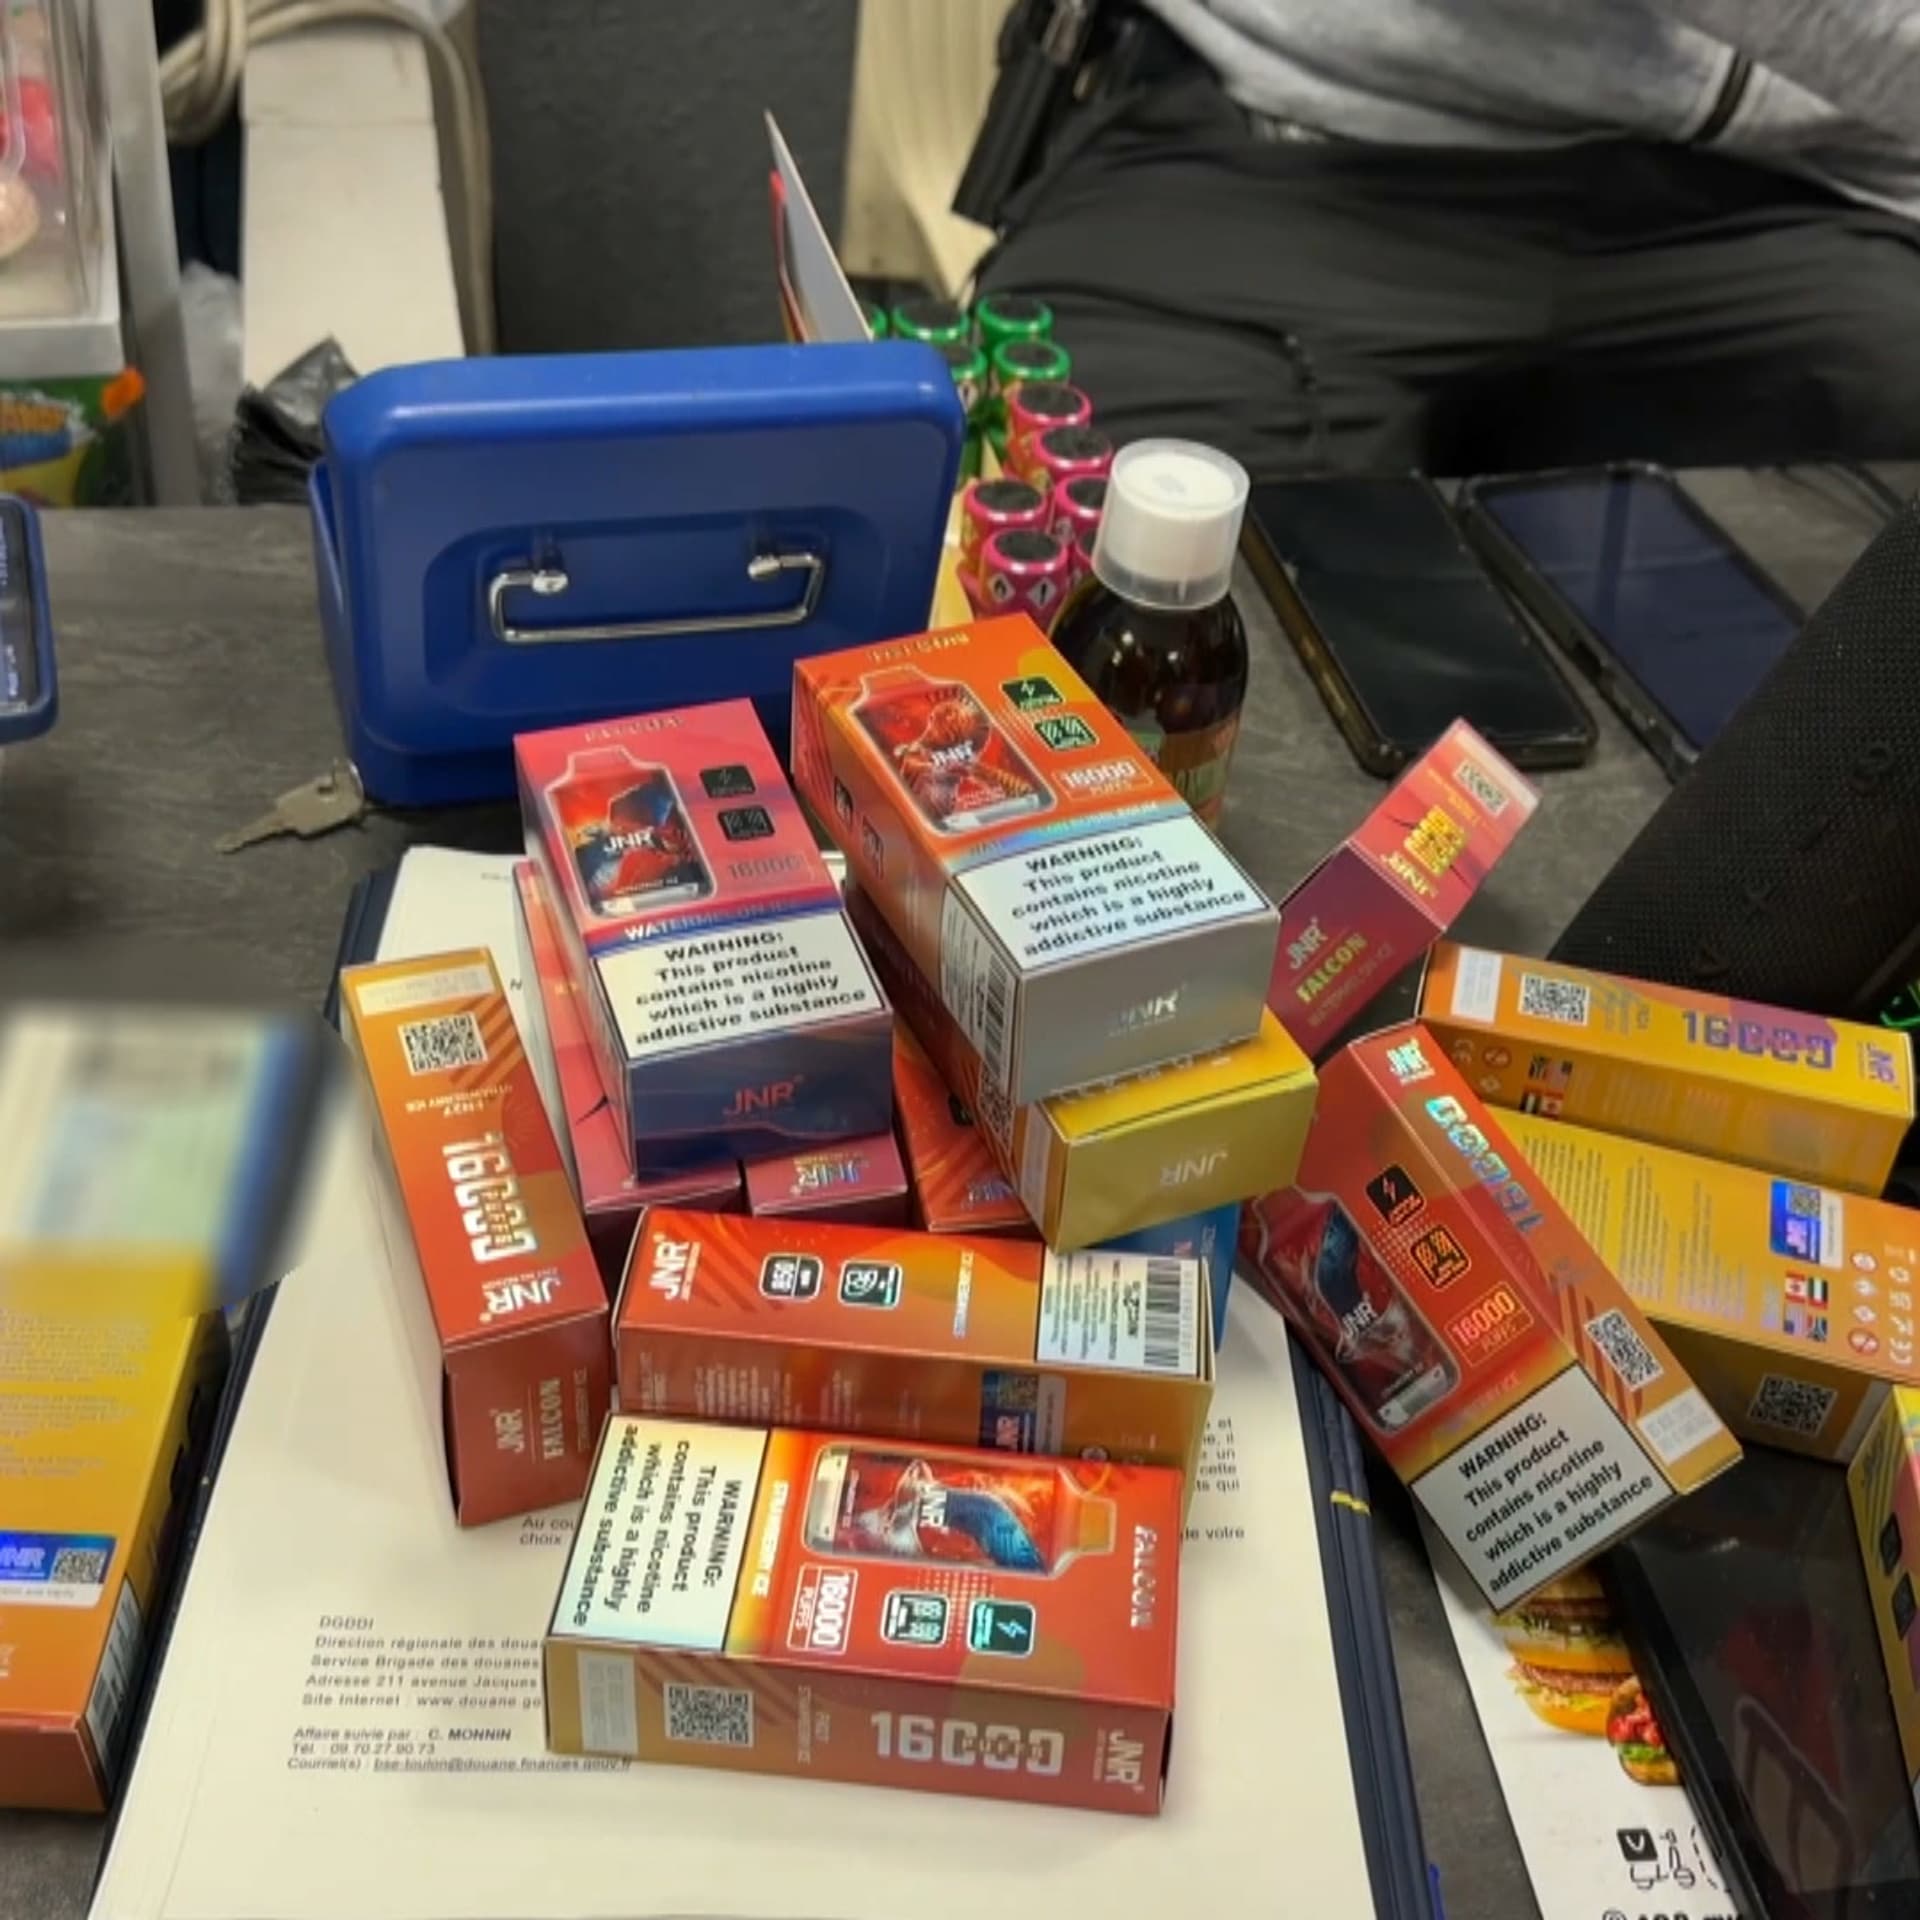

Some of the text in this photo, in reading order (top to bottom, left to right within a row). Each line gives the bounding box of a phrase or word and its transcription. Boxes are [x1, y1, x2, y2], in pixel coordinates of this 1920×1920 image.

[1062, 761, 1136, 788] 16000
[603, 825, 655, 854] JNR
[1026, 836, 1143, 874] WARNING:
[1012, 861, 1201, 920] contains nicotine
[1023, 850, 1163, 895] This product
[1023, 890, 1247, 957] addictive substance
[1030, 877, 1214, 934] which is a highly
[655, 946, 800, 982] This product
[664, 930, 785, 962] WARNING:
[1287, 916, 1329, 970] JNR
[1296, 931, 1368, 1004] FALCON
[636, 959, 832, 1005] contains nicotine
[648, 974, 839, 1022] which is a highly
[636, 990, 866, 1045] addictive substance
[1681, 1009, 1835, 1071] 16000
[723, 1077, 801, 1116] JNR
[1159, 1150, 1228, 1187] JNR
[649, 1237, 689, 1300] JNR
[481, 1275, 560, 1318] JNR
[1342, 1296, 1378, 1336] JNR
[1458, 1412, 1548, 1480] WARNING:
[1463, 1429, 1571, 1509] This product
[658, 1440, 690, 1523] contains
[1465, 1440, 1605, 1543] contains nicotine
[573, 1423, 639, 1627] addictive substance
[603, 1442, 663, 1612] which is a highly
[671, 1464, 717, 1592] This product
[702, 1479, 743, 1588] WARNING:
[919, 1486, 950, 1532] JNR
[1206, 1527, 1245, 1540] votre
[1483, 1460, 1624, 1563] which is a highly
[1488, 1475, 1653, 1594] addictive substance
[520, 1533, 562, 1545] choix
[636, 1528, 670, 1613] nicotine
[1130, 1523, 1158, 1631] FALCON
[318, 1615, 375, 1630] DGDDI
[812, 1573, 851, 1647] 16000
[311, 1654, 540, 1671] Service Brigade des douanes
[314, 1635, 543, 1652] Direction régionale des doua
[302, 1693, 333, 1706] Site
[339, 1694, 401, 1706] Internet
[305, 1674, 538, 1691] Adresse 211 avenue Jacques
[293, 1727, 339, 1741] Affaire
[343, 1727, 384, 1741] suivie
[387, 1729, 411, 1743] par
[448, 1728, 512, 1742] MONNIN
[870, 1710, 1065, 1777] 16000
[1104, 1727, 1146, 1788] JNR
